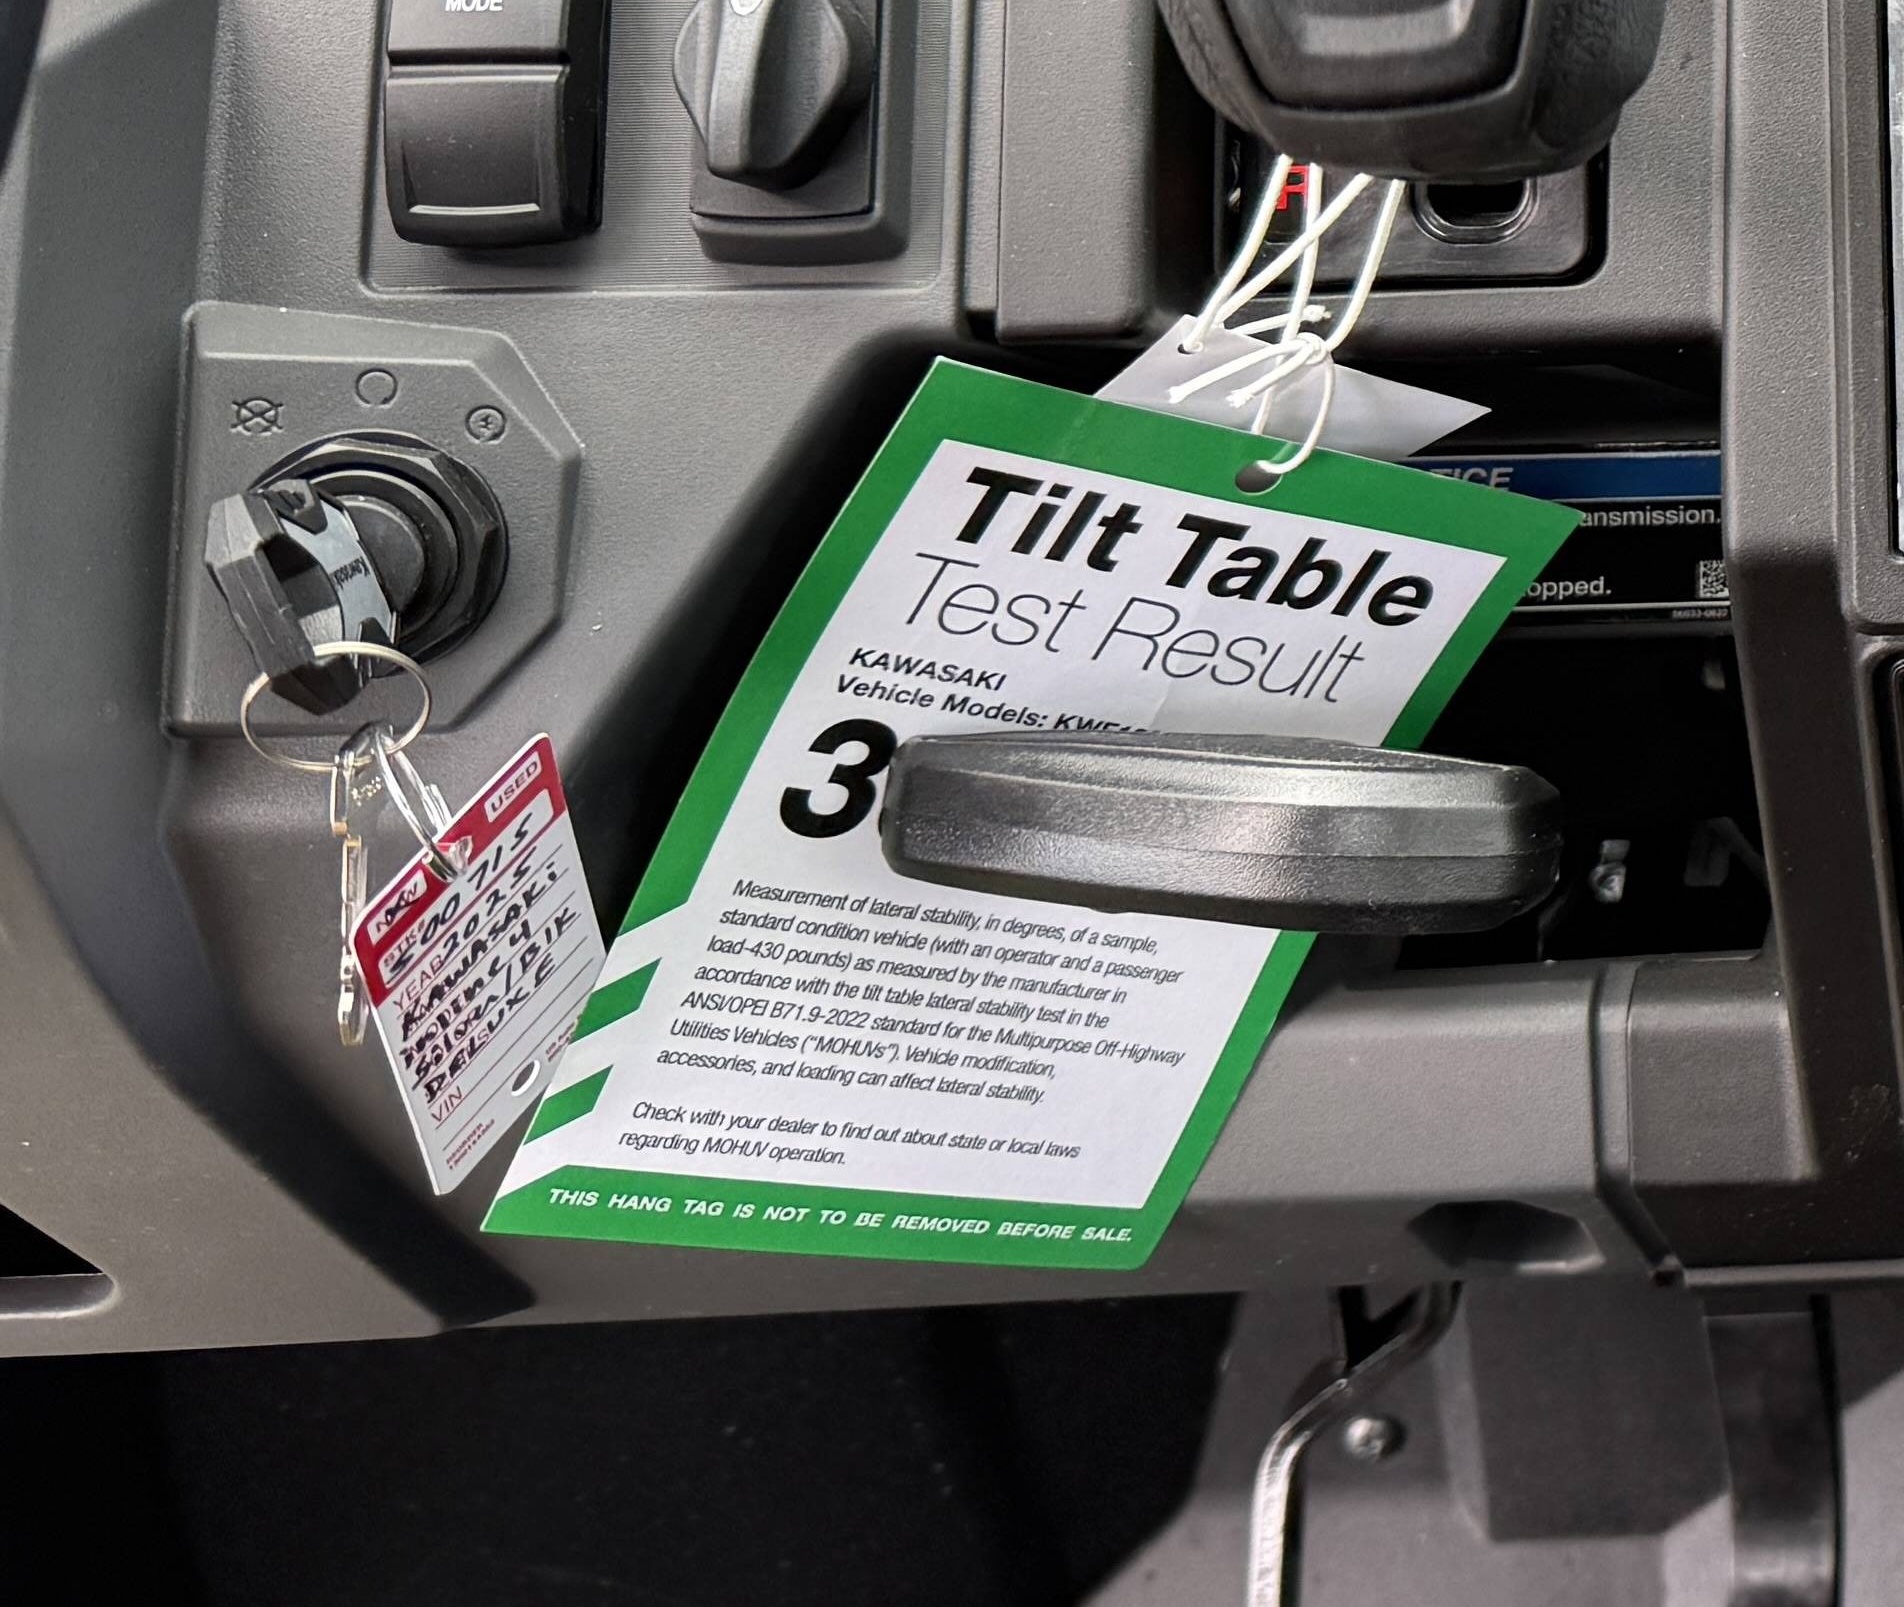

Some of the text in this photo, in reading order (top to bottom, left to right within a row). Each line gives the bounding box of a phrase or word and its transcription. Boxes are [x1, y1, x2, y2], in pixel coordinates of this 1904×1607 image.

[955, 466, 1434, 627] Tilt Table
[1580, 505, 1722, 526] ansmission.
[905, 552, 1365, 704] Test Result
[848, 647, 1007, 691] KAWASAKI
[837, 674, 935, 708] Vehicle
[940, 693, 1049, 727] Models:
[490, 761, 539, 814] USED
[719, 908, 1184, 985] standard condition vehicle (with an operator and a passenger
[732, 879, 1157, 955] Measurement of lateral stability, in degrees, of a sample,
[694, 965, 1110, 1029] accordance with the tilt table lateral stability test in the
[706, 934, 1128, 1004] load-430 pounds) as measured by the manufacturer in
[670, 1018, 731, 1042] Utilities
[733, 1025, 800, 1050] Vehicles
[905, 1044, 959, 1067] Vehicle
[960, 1055, 1055, 1080] modification,
[769, 1001, 871, 1029] B71.9-2022
[870, 1015, 943, 1037] standard
[942, 1021, 967, 1039] for
[966, 1025, 993, 1043] the
[993, 1027, 1092, 1054] Multipurpose
[1094, 1039, 1186, 1068] Off-Highway
[431, 1085, 464, 1123] VIN
[656, 1049, 1045, 1106] accessories, and loading can affect lateral stability.
[549, 1188, 1132, 1242] THIS HANG TAG IS NOT TO BE REMOVED BEFORE SALE.
